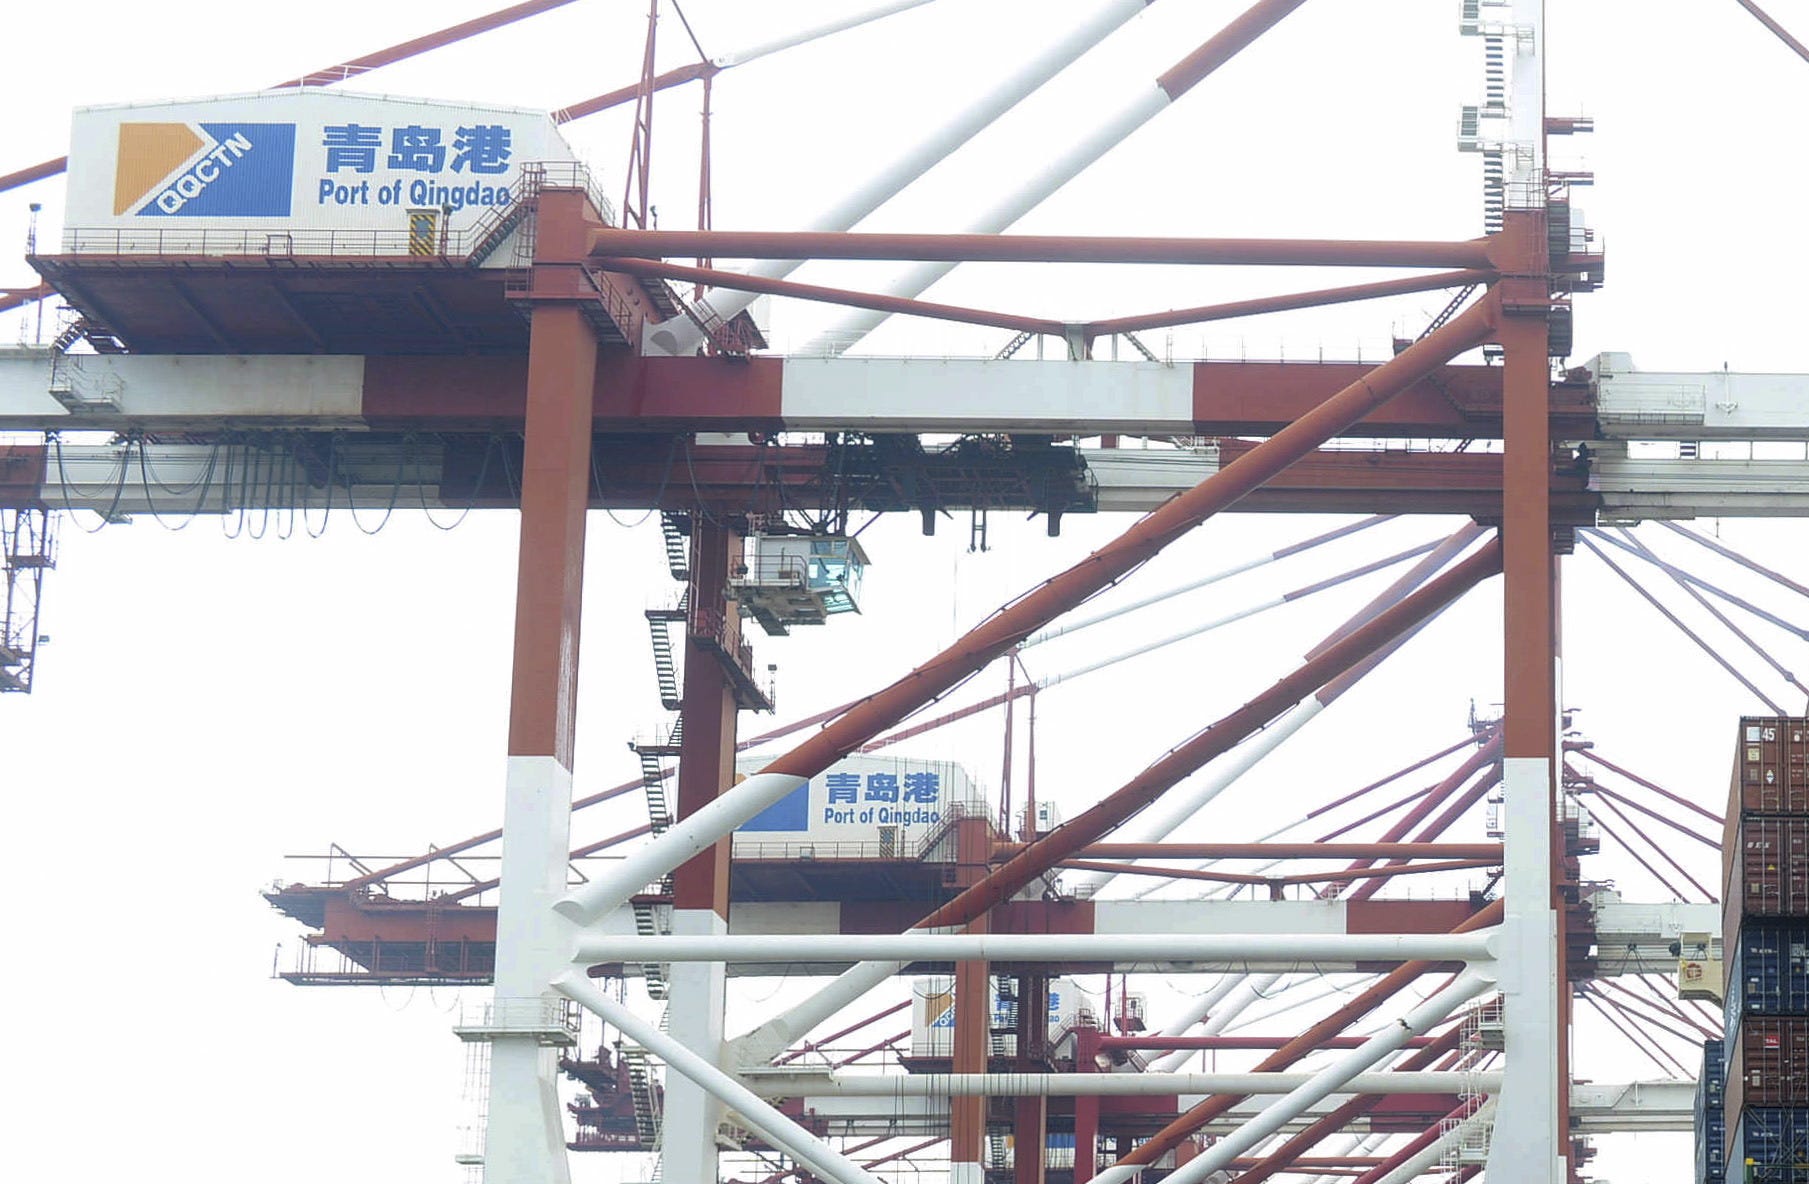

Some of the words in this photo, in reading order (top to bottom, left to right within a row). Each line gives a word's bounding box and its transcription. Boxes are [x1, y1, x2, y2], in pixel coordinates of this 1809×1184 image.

[322, 123, 512, 174] 青岛港
[156, 131, 253, 216] QQCTN
[319, 179, 369, 205] Port
[378, 179, 402, 205] of
[410, 179, 510, 212] Qingdao
[1762, 728, 1776, 741] 45
[825, 772, 939, 805] 青岛港
[823, 807, 855, 825] Port
[859, 807, 875, 825] of
[877, 806, 940, 828] Qingdao
